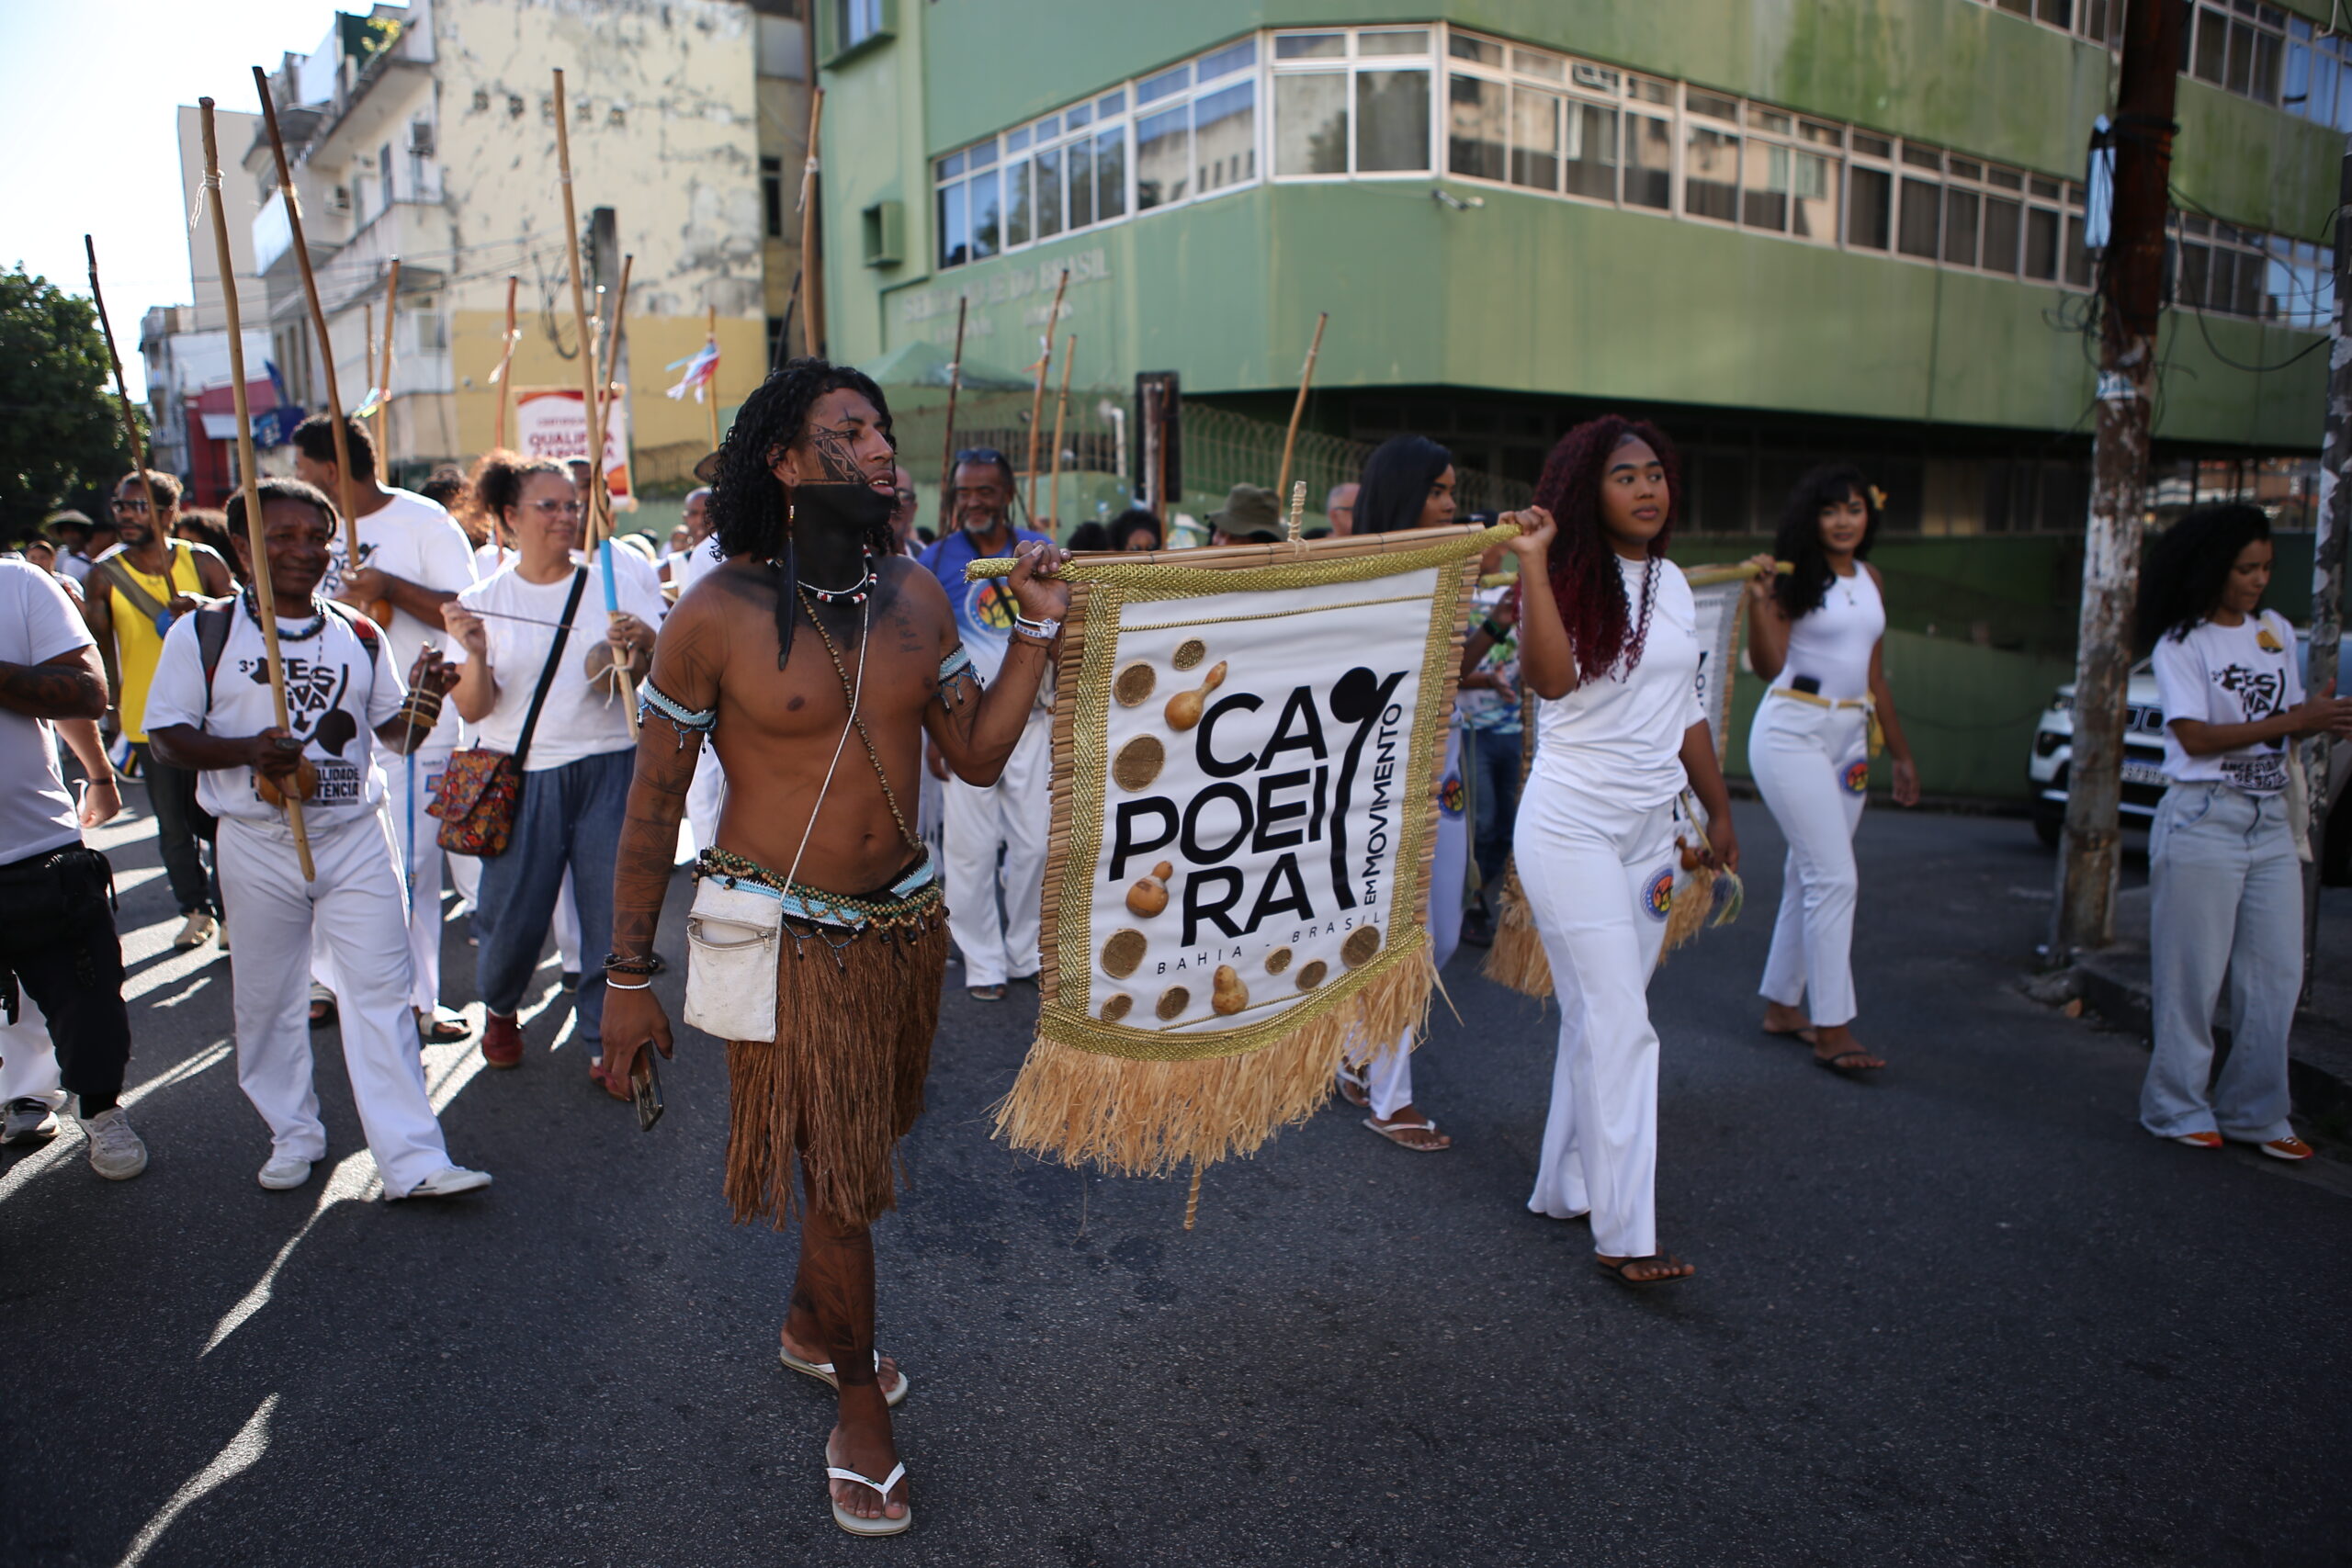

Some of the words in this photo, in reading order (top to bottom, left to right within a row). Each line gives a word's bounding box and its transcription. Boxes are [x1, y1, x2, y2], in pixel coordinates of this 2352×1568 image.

[1362, 703, 1402, 878] MOVIMENTO
[1363, 879, 1376, 906] EM
[1157, 947, 1242, 975] BAHIA
[1291, 912, 1380, 943] BRASIL
